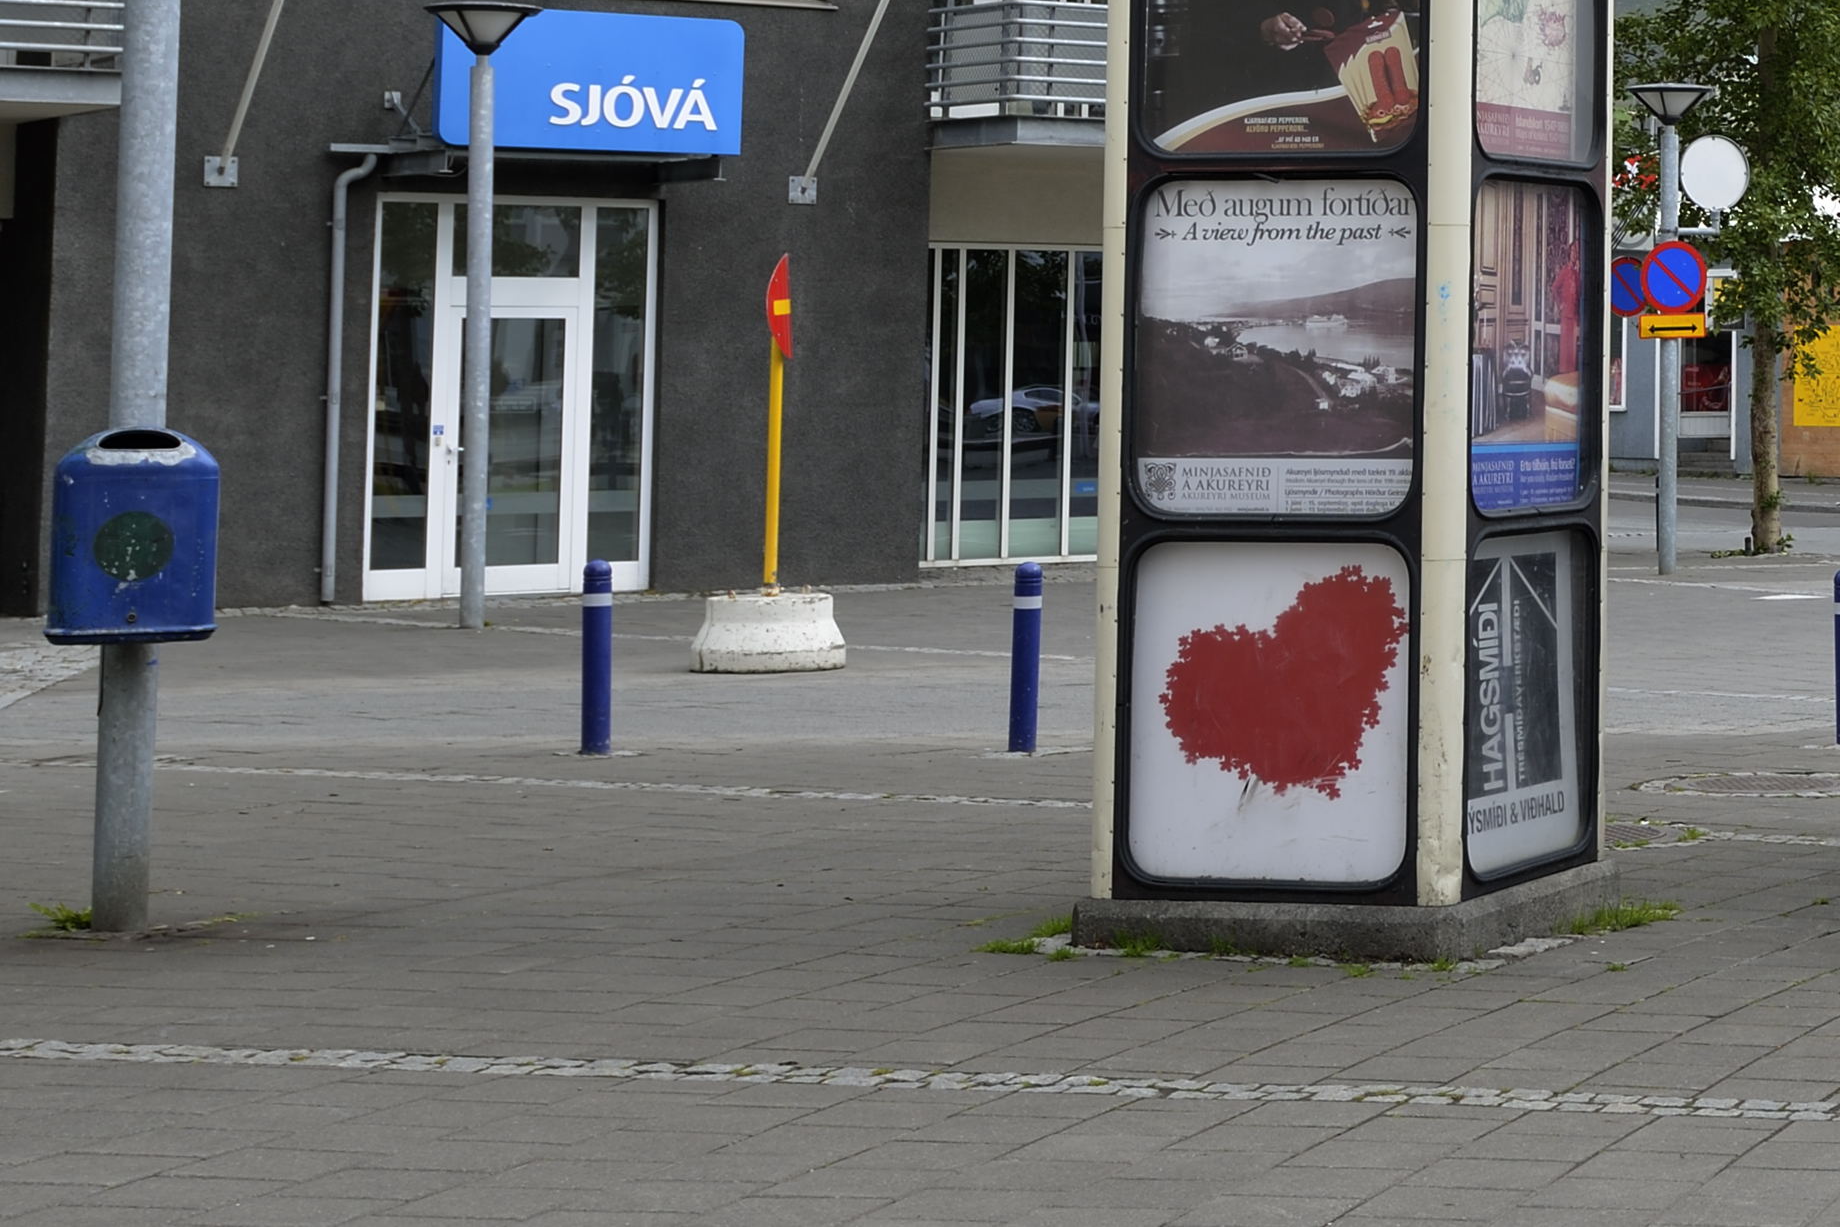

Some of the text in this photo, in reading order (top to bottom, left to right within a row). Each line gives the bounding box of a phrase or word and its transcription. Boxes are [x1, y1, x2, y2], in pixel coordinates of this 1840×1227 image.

[549, 74, 718, 131] SJÓVÁ
[1155, 188, 1413, 224] Með augum fortíðar
[1182, 221, 1382, 246] A view from the past
[1181, 467, 1271, 478] MINJASAFNIÐ
[1195, 479, 1270, 491] AKUREYRI
[1473, 602, 1505, 791] HAGSMÍÐI
[1510, 802, 1519, 824] &
[1520, 791, 1565, 822] VIÐHALD
